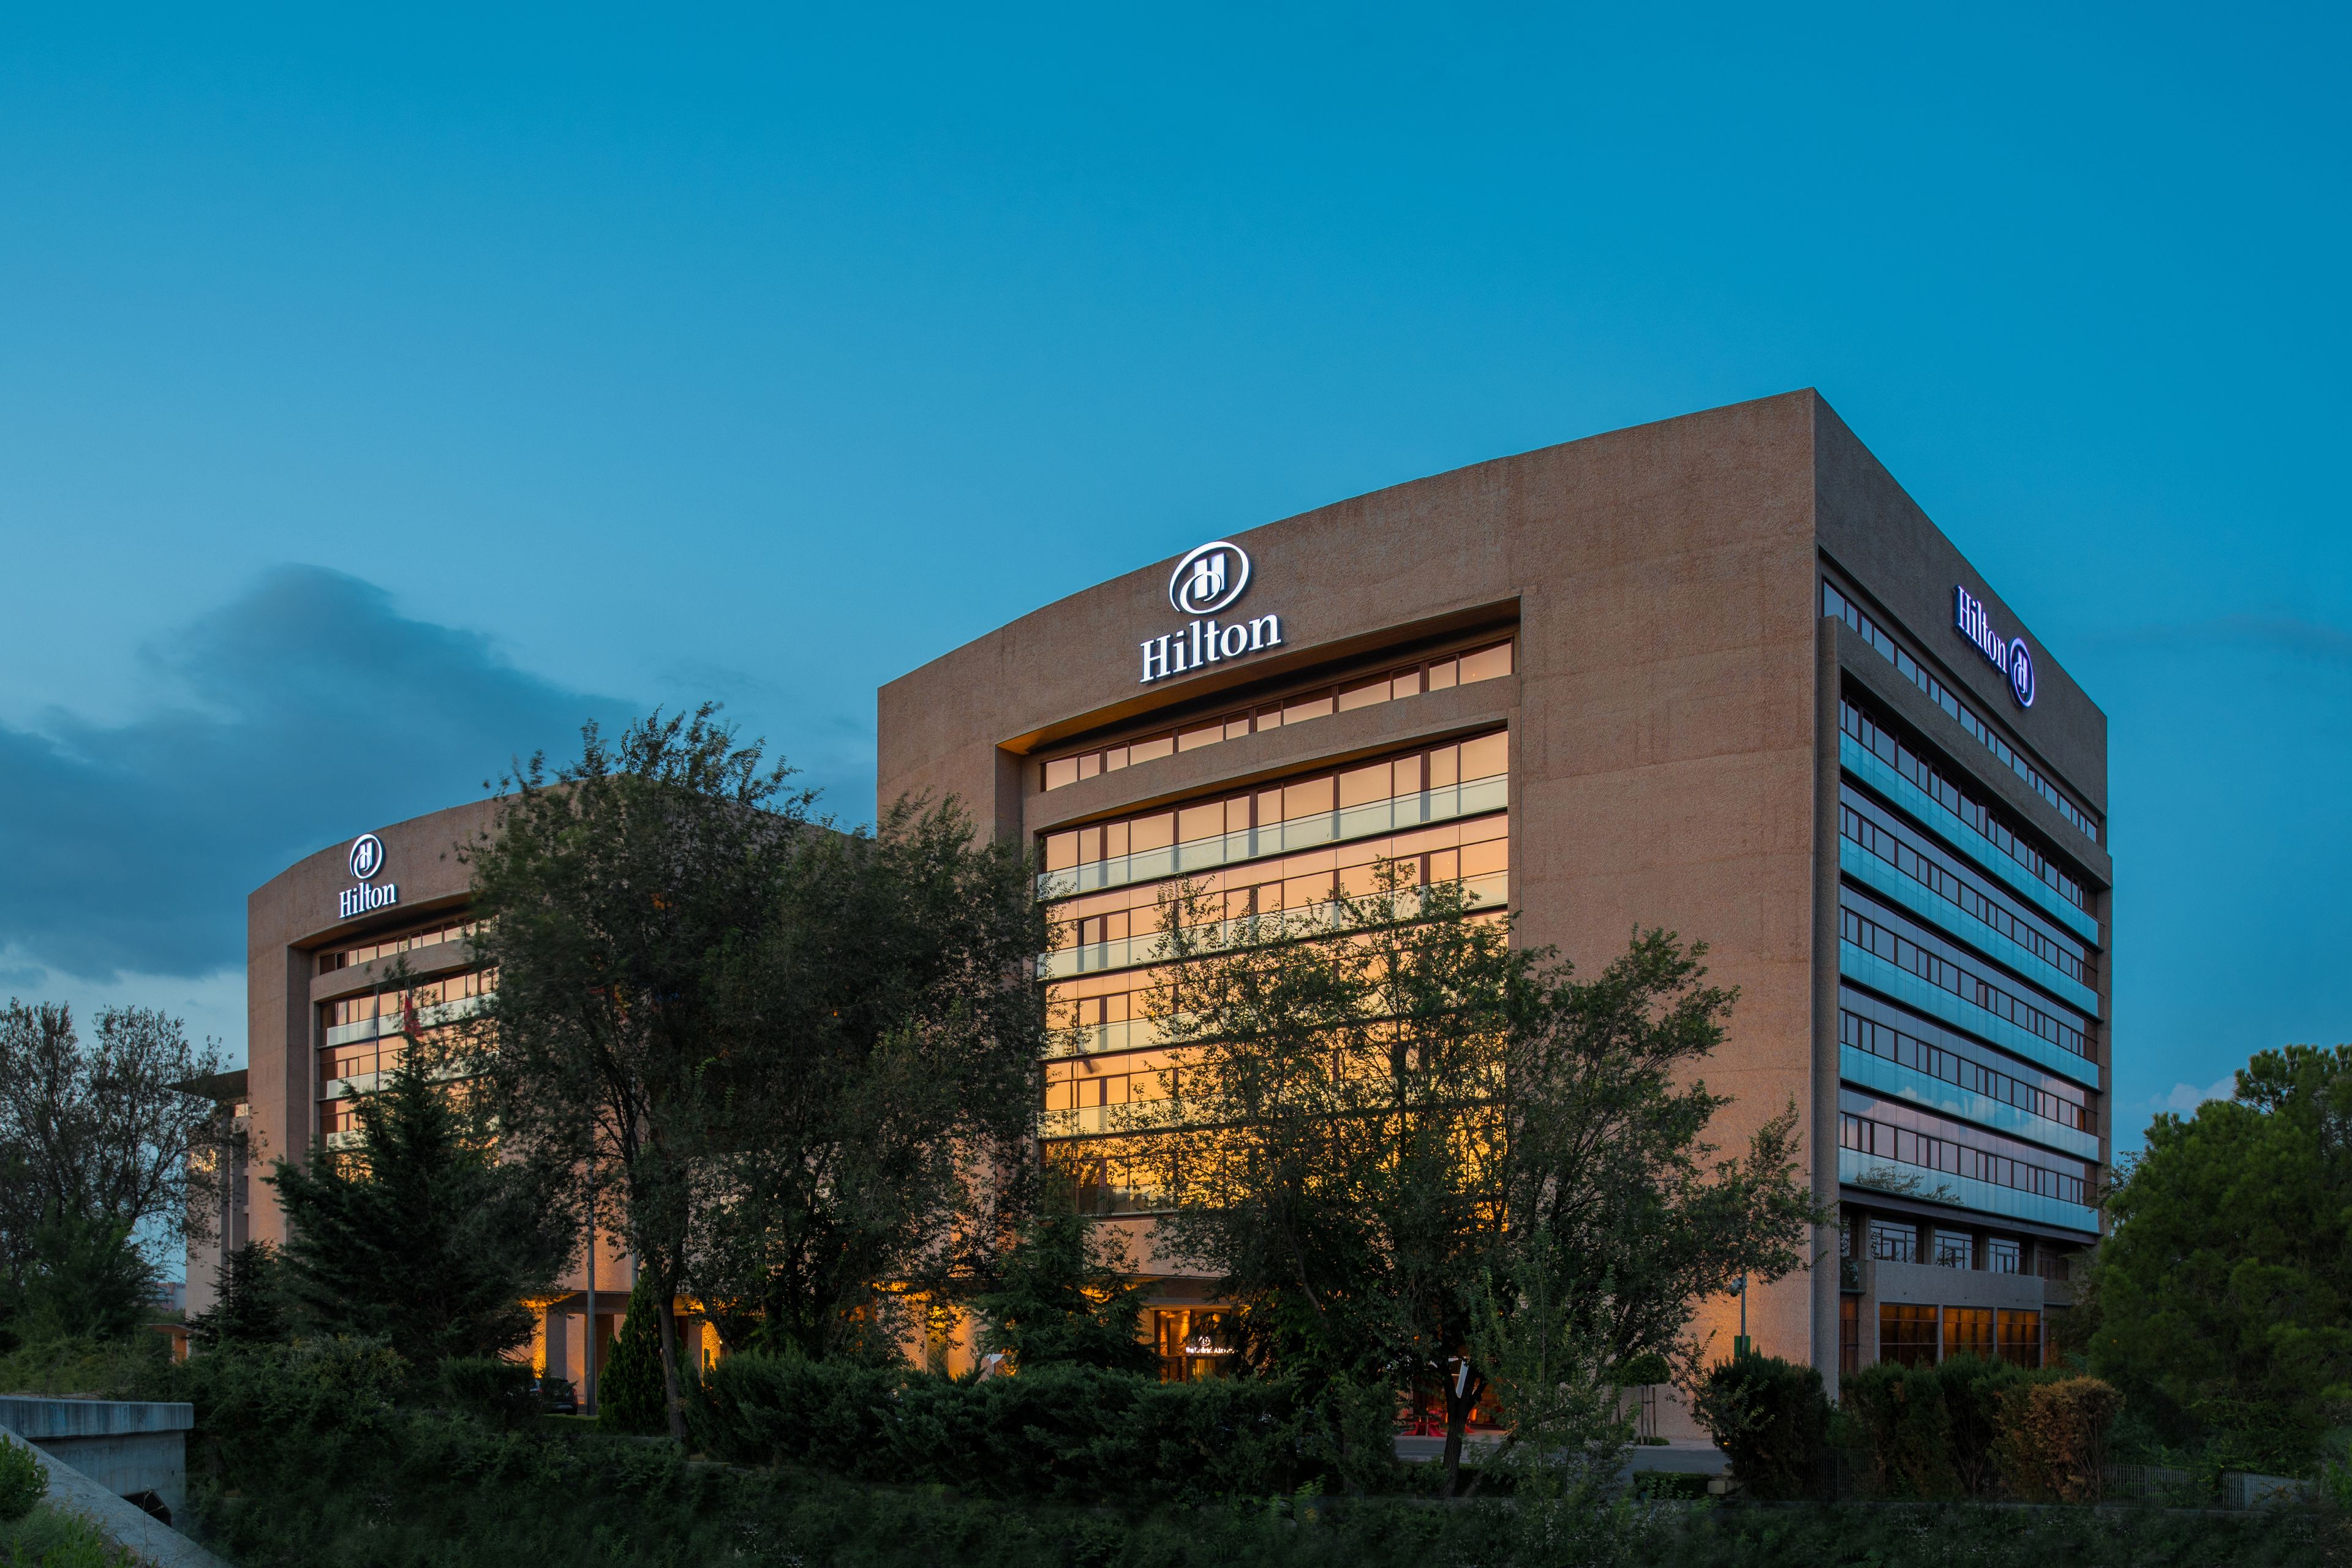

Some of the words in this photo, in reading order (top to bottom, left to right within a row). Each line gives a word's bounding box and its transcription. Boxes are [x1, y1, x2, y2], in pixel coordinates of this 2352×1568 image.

[1140, 614, 1281, 683] Hilton
[1958, 586, 2007, 674] Hilton
[339, 882, 396, 918] Hilton
